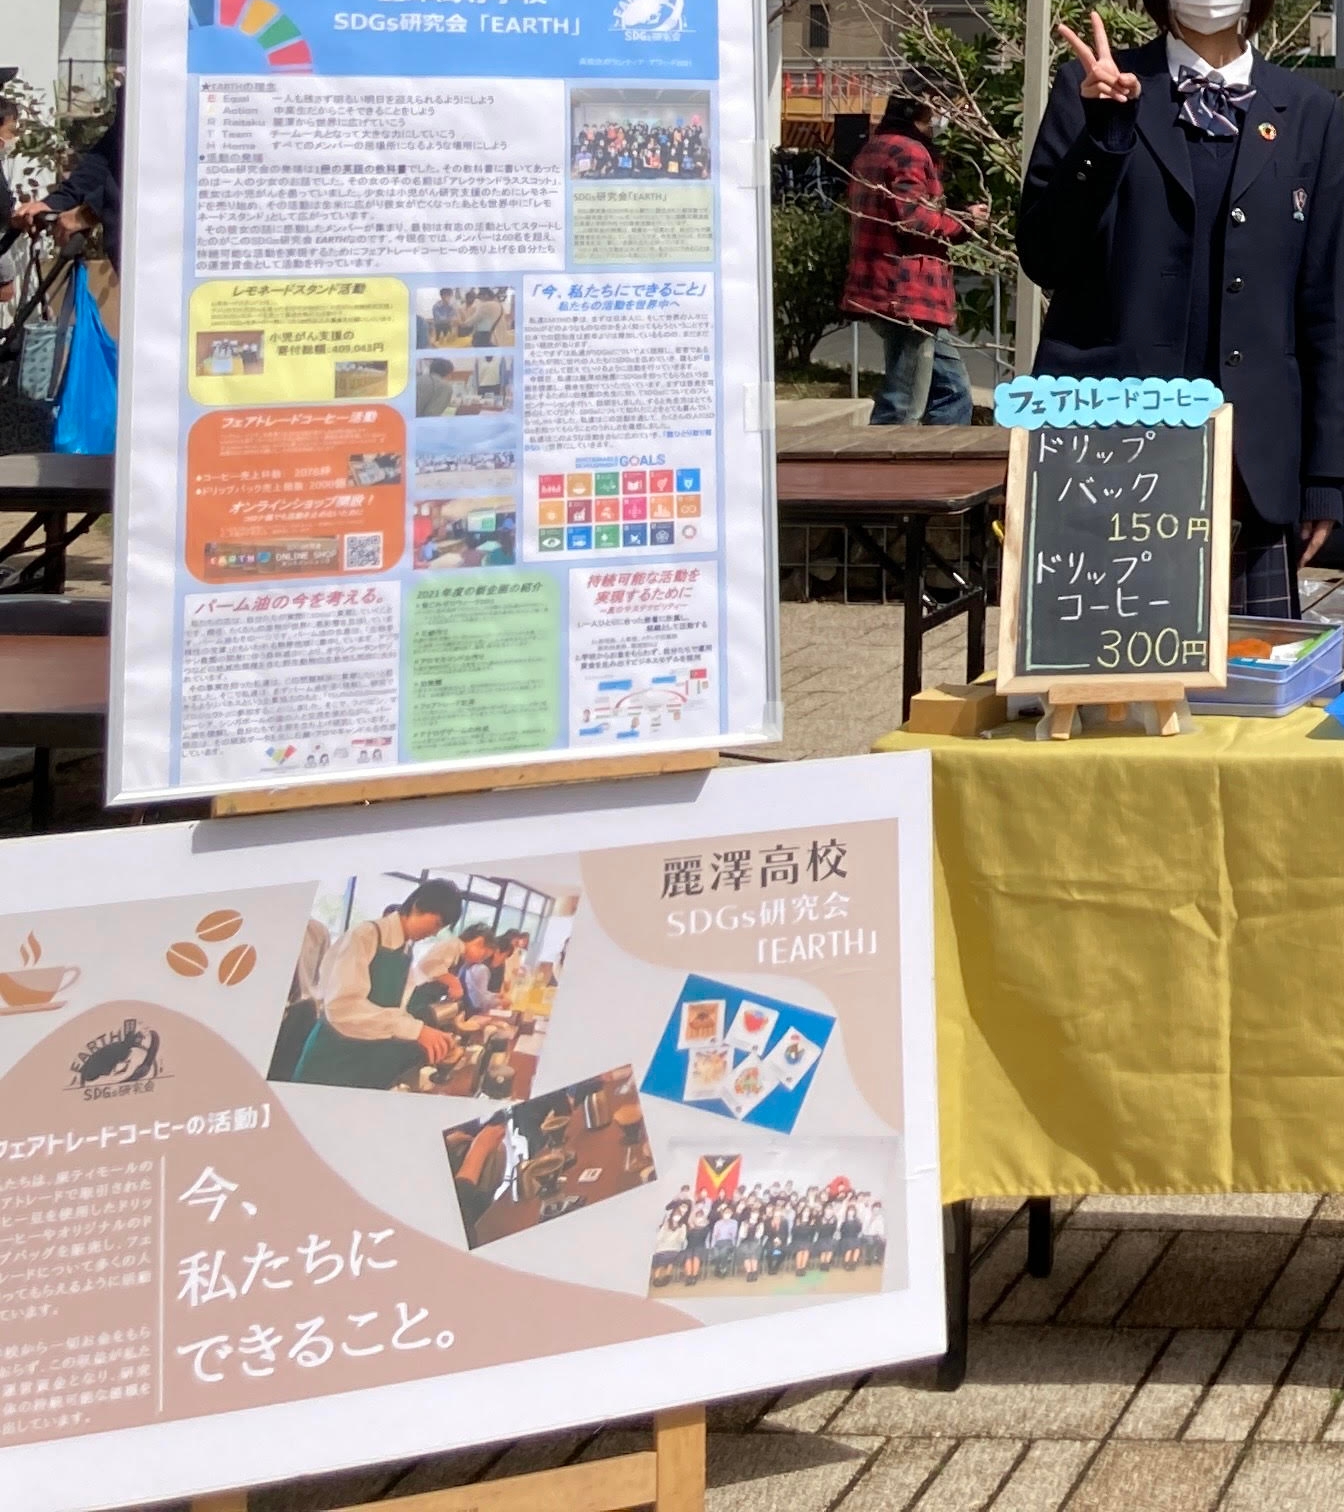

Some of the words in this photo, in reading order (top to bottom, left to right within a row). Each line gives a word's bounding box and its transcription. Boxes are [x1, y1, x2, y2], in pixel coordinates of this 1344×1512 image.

[333, 12, 581, 36] SDGs研究会「EARTH」
[232, 282, 367, 297] レモネードスタンド活動
[269, 331, 355, 342] 小児がん支援の
[1009, 388, 1210, 414] フェアトレードコーヒー
[221, 410, 378, 429] フェアトレードコーヒー活動
[1037, 430, 1157, 465] ドリップ
[1056, 472, 1160, 505] バック
[1107, 512, 1210, 543] 150円
[587, 568, 700, 588] 持続可能な活動を
[1035, 550, 1153, 586] ドリップ
[194, 588, 384, 614] パーム油の今を考える。
[594, 586, 693, 605] 実現するために
[1057, 587, 1171, 622] コーヒー
[1096, 627, 1208, 668] 300円
[660, 838, 848, 900] 麗澤高校
[666, 891, 851, 937] SDGs研究会
[758, 928, 878, 965] 「EARTH」
[70, 1029, 122, 1073] EARTH
[178, 1166, 257, 1223] 今、
[177, 1228, 398, 1307] 私たちに
[177, 1301, 455, 1382] できること。
